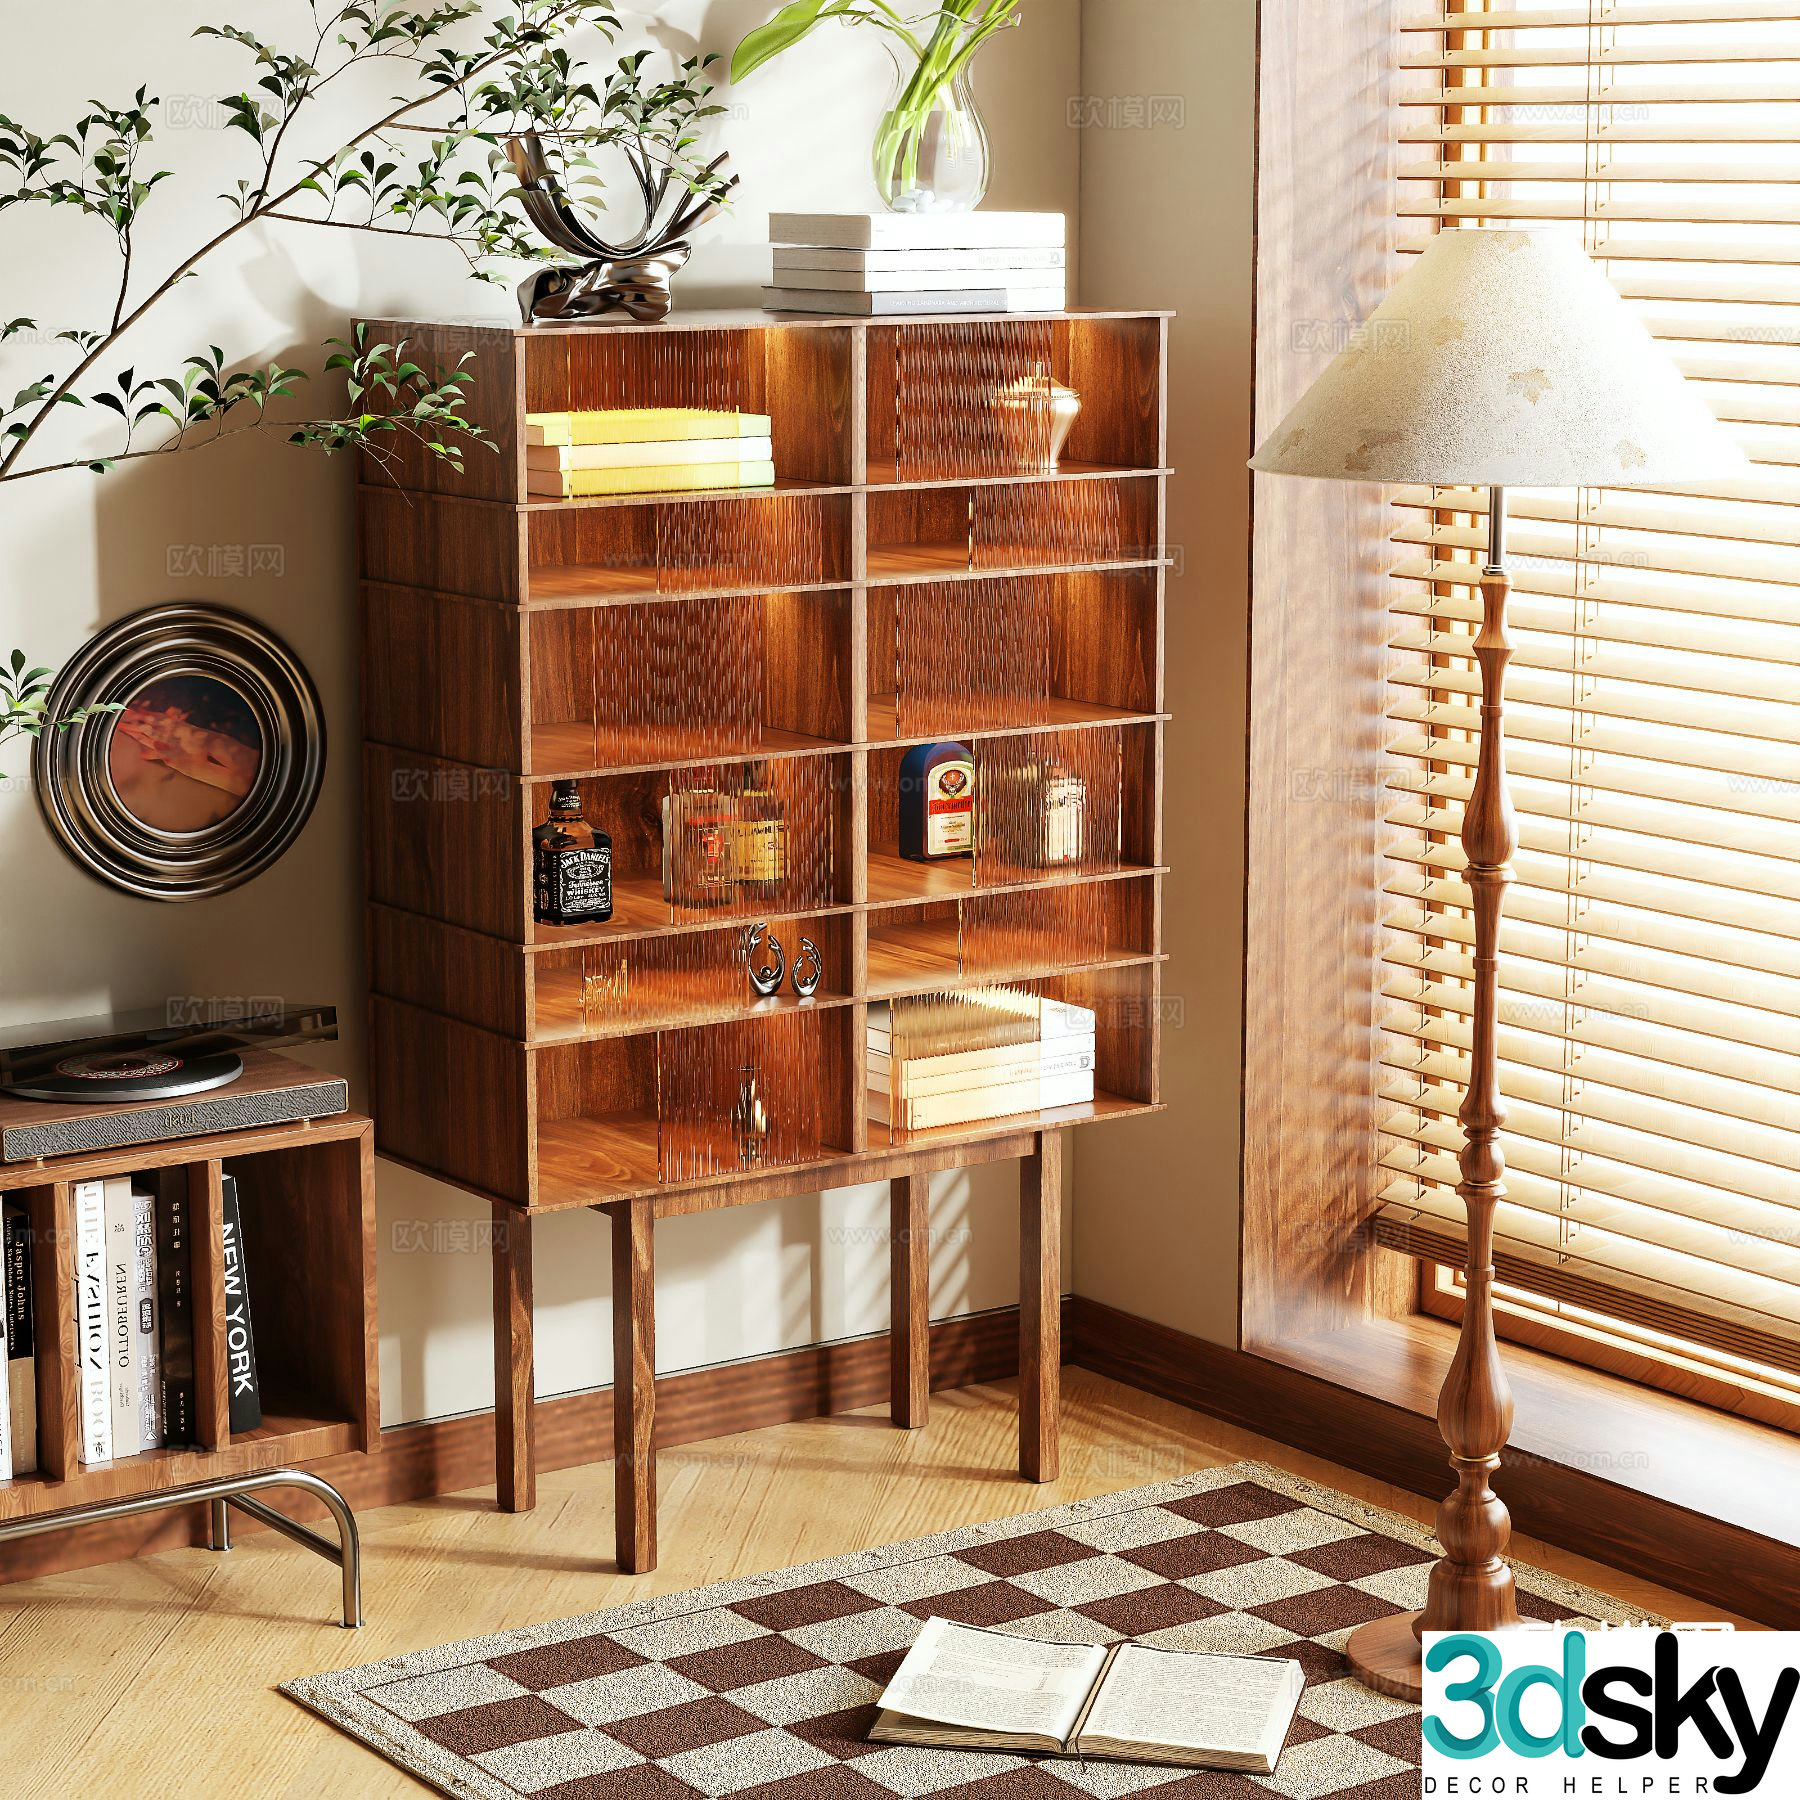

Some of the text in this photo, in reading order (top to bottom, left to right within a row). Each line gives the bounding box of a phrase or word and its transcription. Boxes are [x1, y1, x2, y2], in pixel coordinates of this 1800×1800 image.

[560, 854, 581, 869] JACK
[566, 886, 606, 896] WHISKEY
[14, 1241, 26, 1321] Jasper Johns
[221, 1221, 255, 1398] NEW YORK
